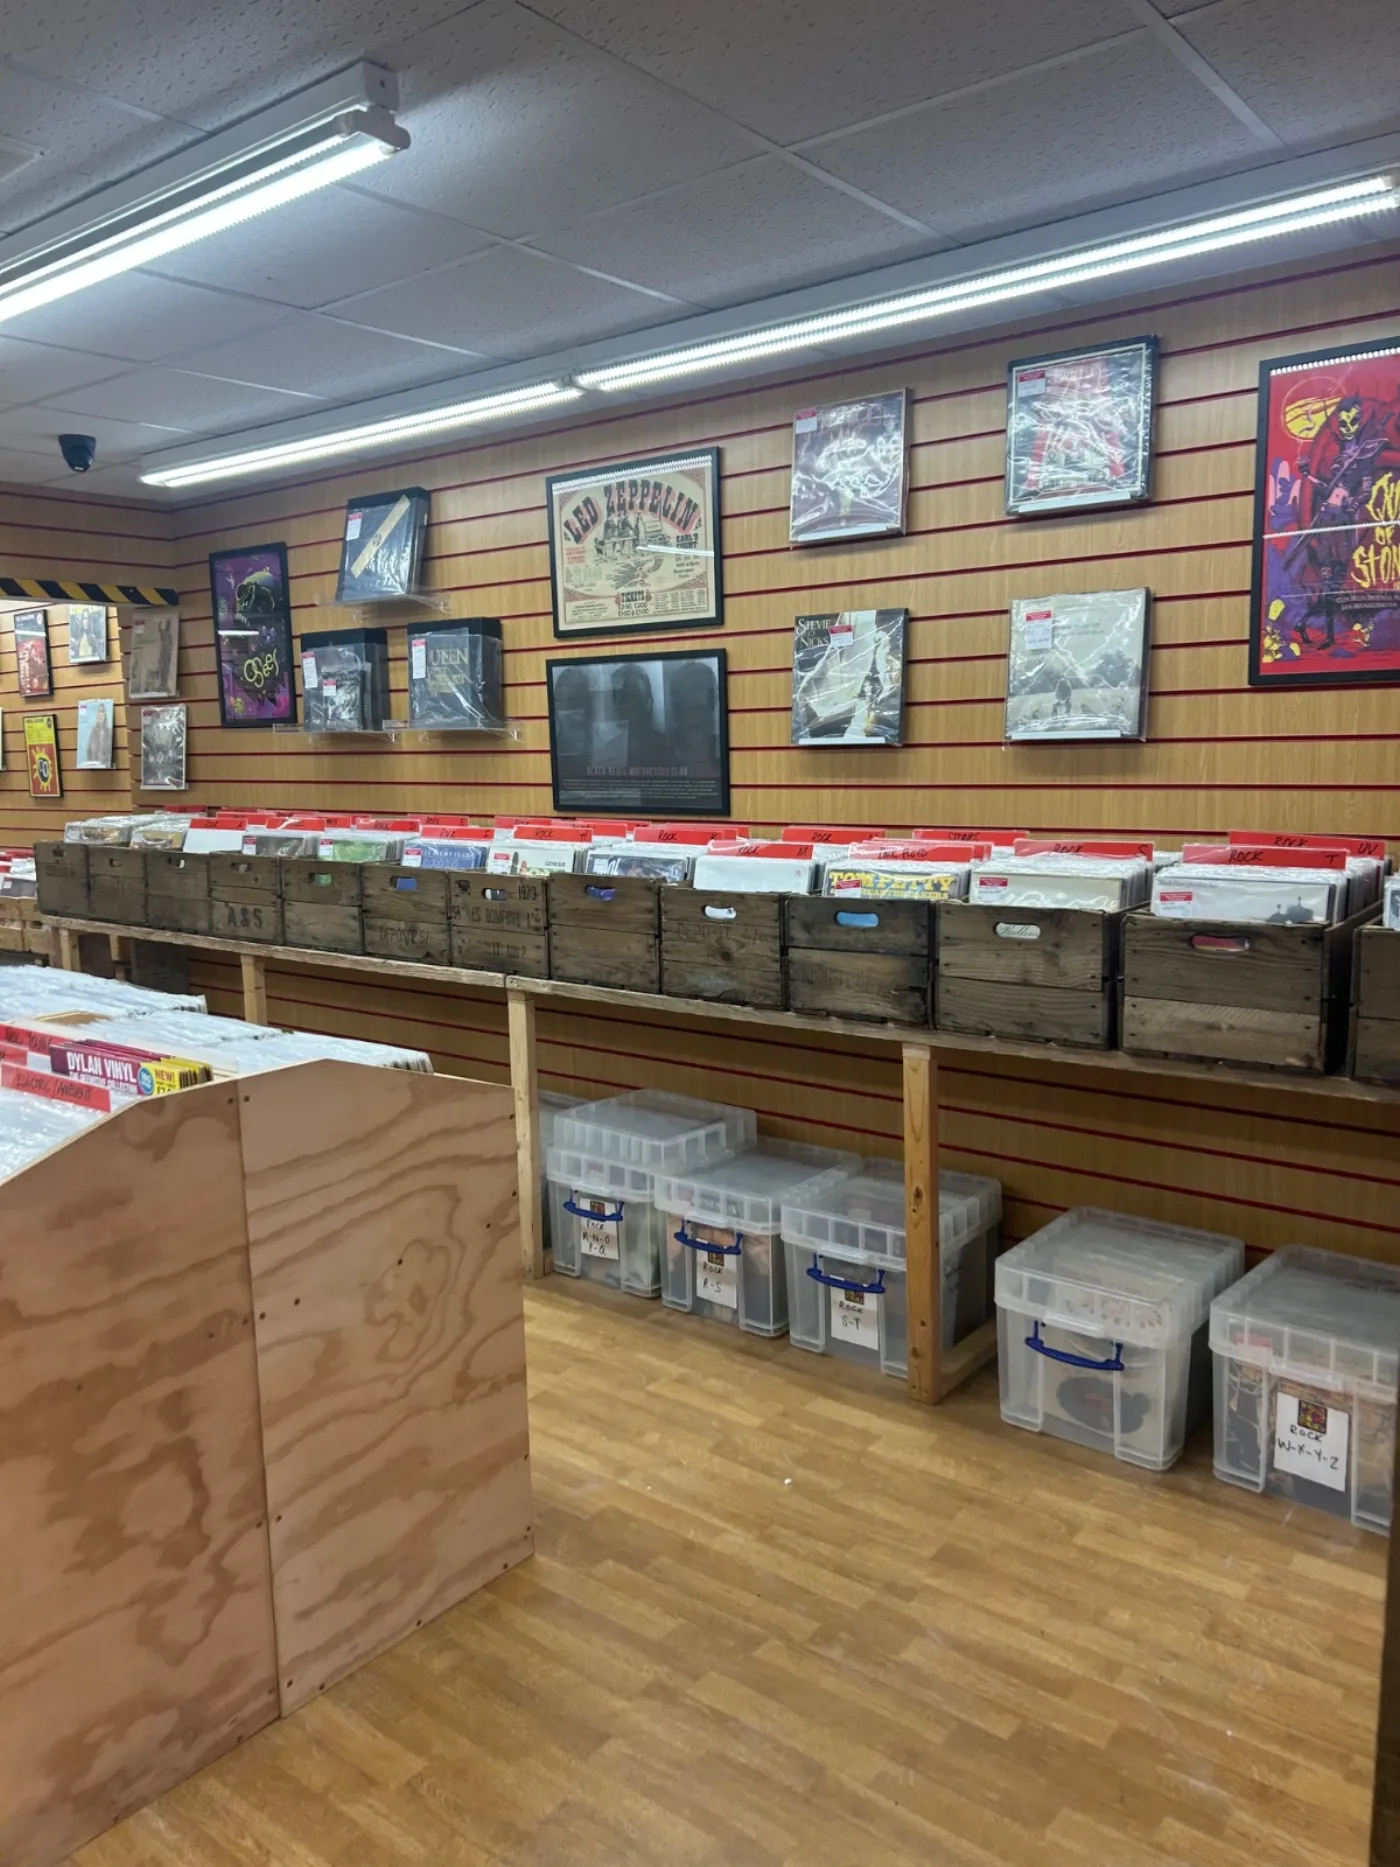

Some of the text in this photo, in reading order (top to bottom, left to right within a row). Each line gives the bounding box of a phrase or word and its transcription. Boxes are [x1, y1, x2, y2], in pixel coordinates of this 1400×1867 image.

[563, 479, 699, 544] LED ZEPPELIN
[798, 618, 831, 636] STEVIE
[800, 635, 830, 647] NICKS
[535, 828, 554, 838] ROCK
[658, 830, 678, 841] ROCK
[811, 831, 833, 842] ROCK
[738, 847, 760, 856] ROCK
[1229, 849, 1340, 865] ROCK T
[66, 1051, 103, 1076] DYLAN
[103, 1057, 137, 1083] VINYL
[155, 1067, 176, 1084] NEW!
[586, 1221, 605, 1231] ROCK
[703, 1261, 723, 1275] ROCK
[703, 1280, 722, 1294] R-S
[838, 1300, 864, 1314] ROCK
[841, 1314, 862, 1331] S-T
[1289, 1423, 1324, 1443] ROCK
